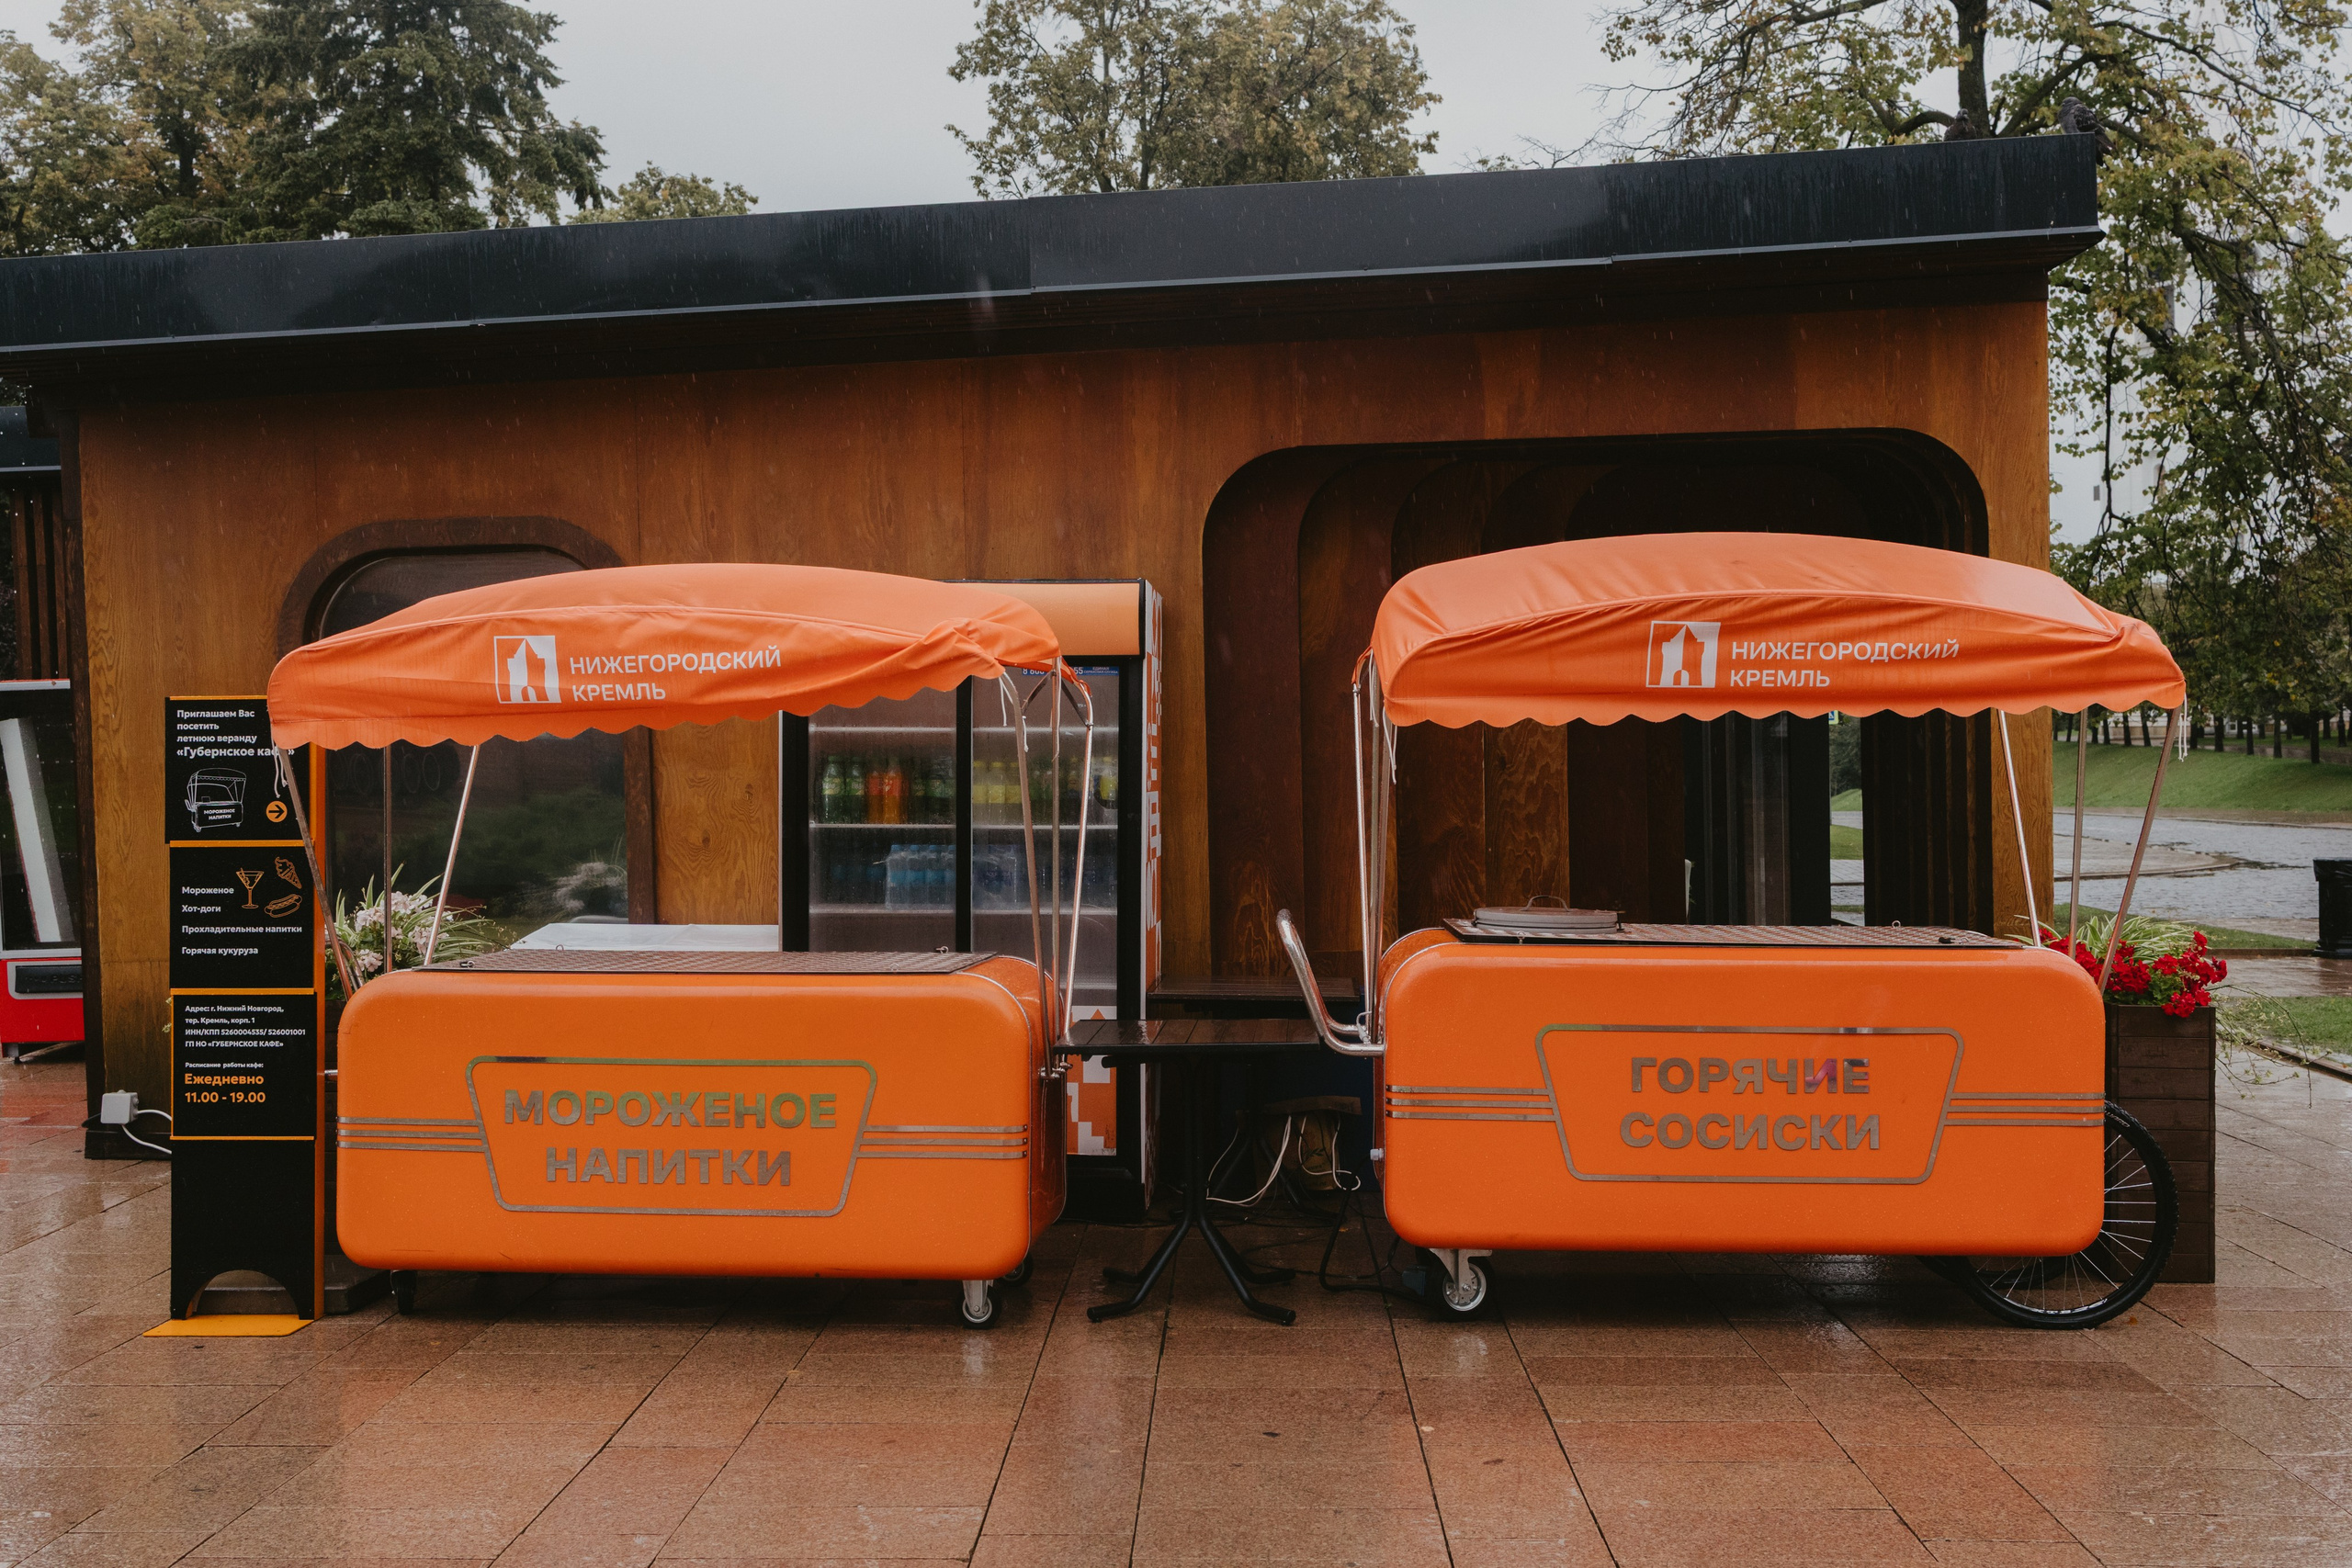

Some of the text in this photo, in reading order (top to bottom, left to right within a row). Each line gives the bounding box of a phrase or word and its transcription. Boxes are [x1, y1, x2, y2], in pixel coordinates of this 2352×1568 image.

[1731, 638, 1960, 663] НИЖЕГОРОДСКИЙ
[569, 644, 782, 675] НИЖЕГОРОДСКИЙ
[1730, 670, 1831, 687] КРЕМЛЬ
[571, 682, 666, 702] КРЕМЛЬ
[176, 709, 255, 719] Приглашаем Вас
[217, 735, 257, 744] веранду
[176, 745, 295, 759] «Губернское каф»
[181, 886, 234, 896] Мороженое
[181, 905, 221, 913] Хот-доги
[181, 925, 265, 934] Прохладительные
[181, 946, 259, 955] Горячая кукуруза
[217, 1004, 246, 1012] Нижний
[247, 1005, 285, 1013] Новгород,
[200, 1017, 230, 1025] Кремль,
[222, 1061, 246, 1069] работы
[184, 1073, 265, 1086] Ежедневно
[1631, 1056, 1870, 1094] ГОРЯЧИЕ
[185, 1091, 219, 1103] 11.00
[230, 1091, 266, 1103] 19.00
[503, 1089, 837, 1129] МОРОЖЕНОЕ
[1620, 1111, 1881, 1151] СОСИСКИ
[546, 1146, 791, 1186] НАПИТКИ
